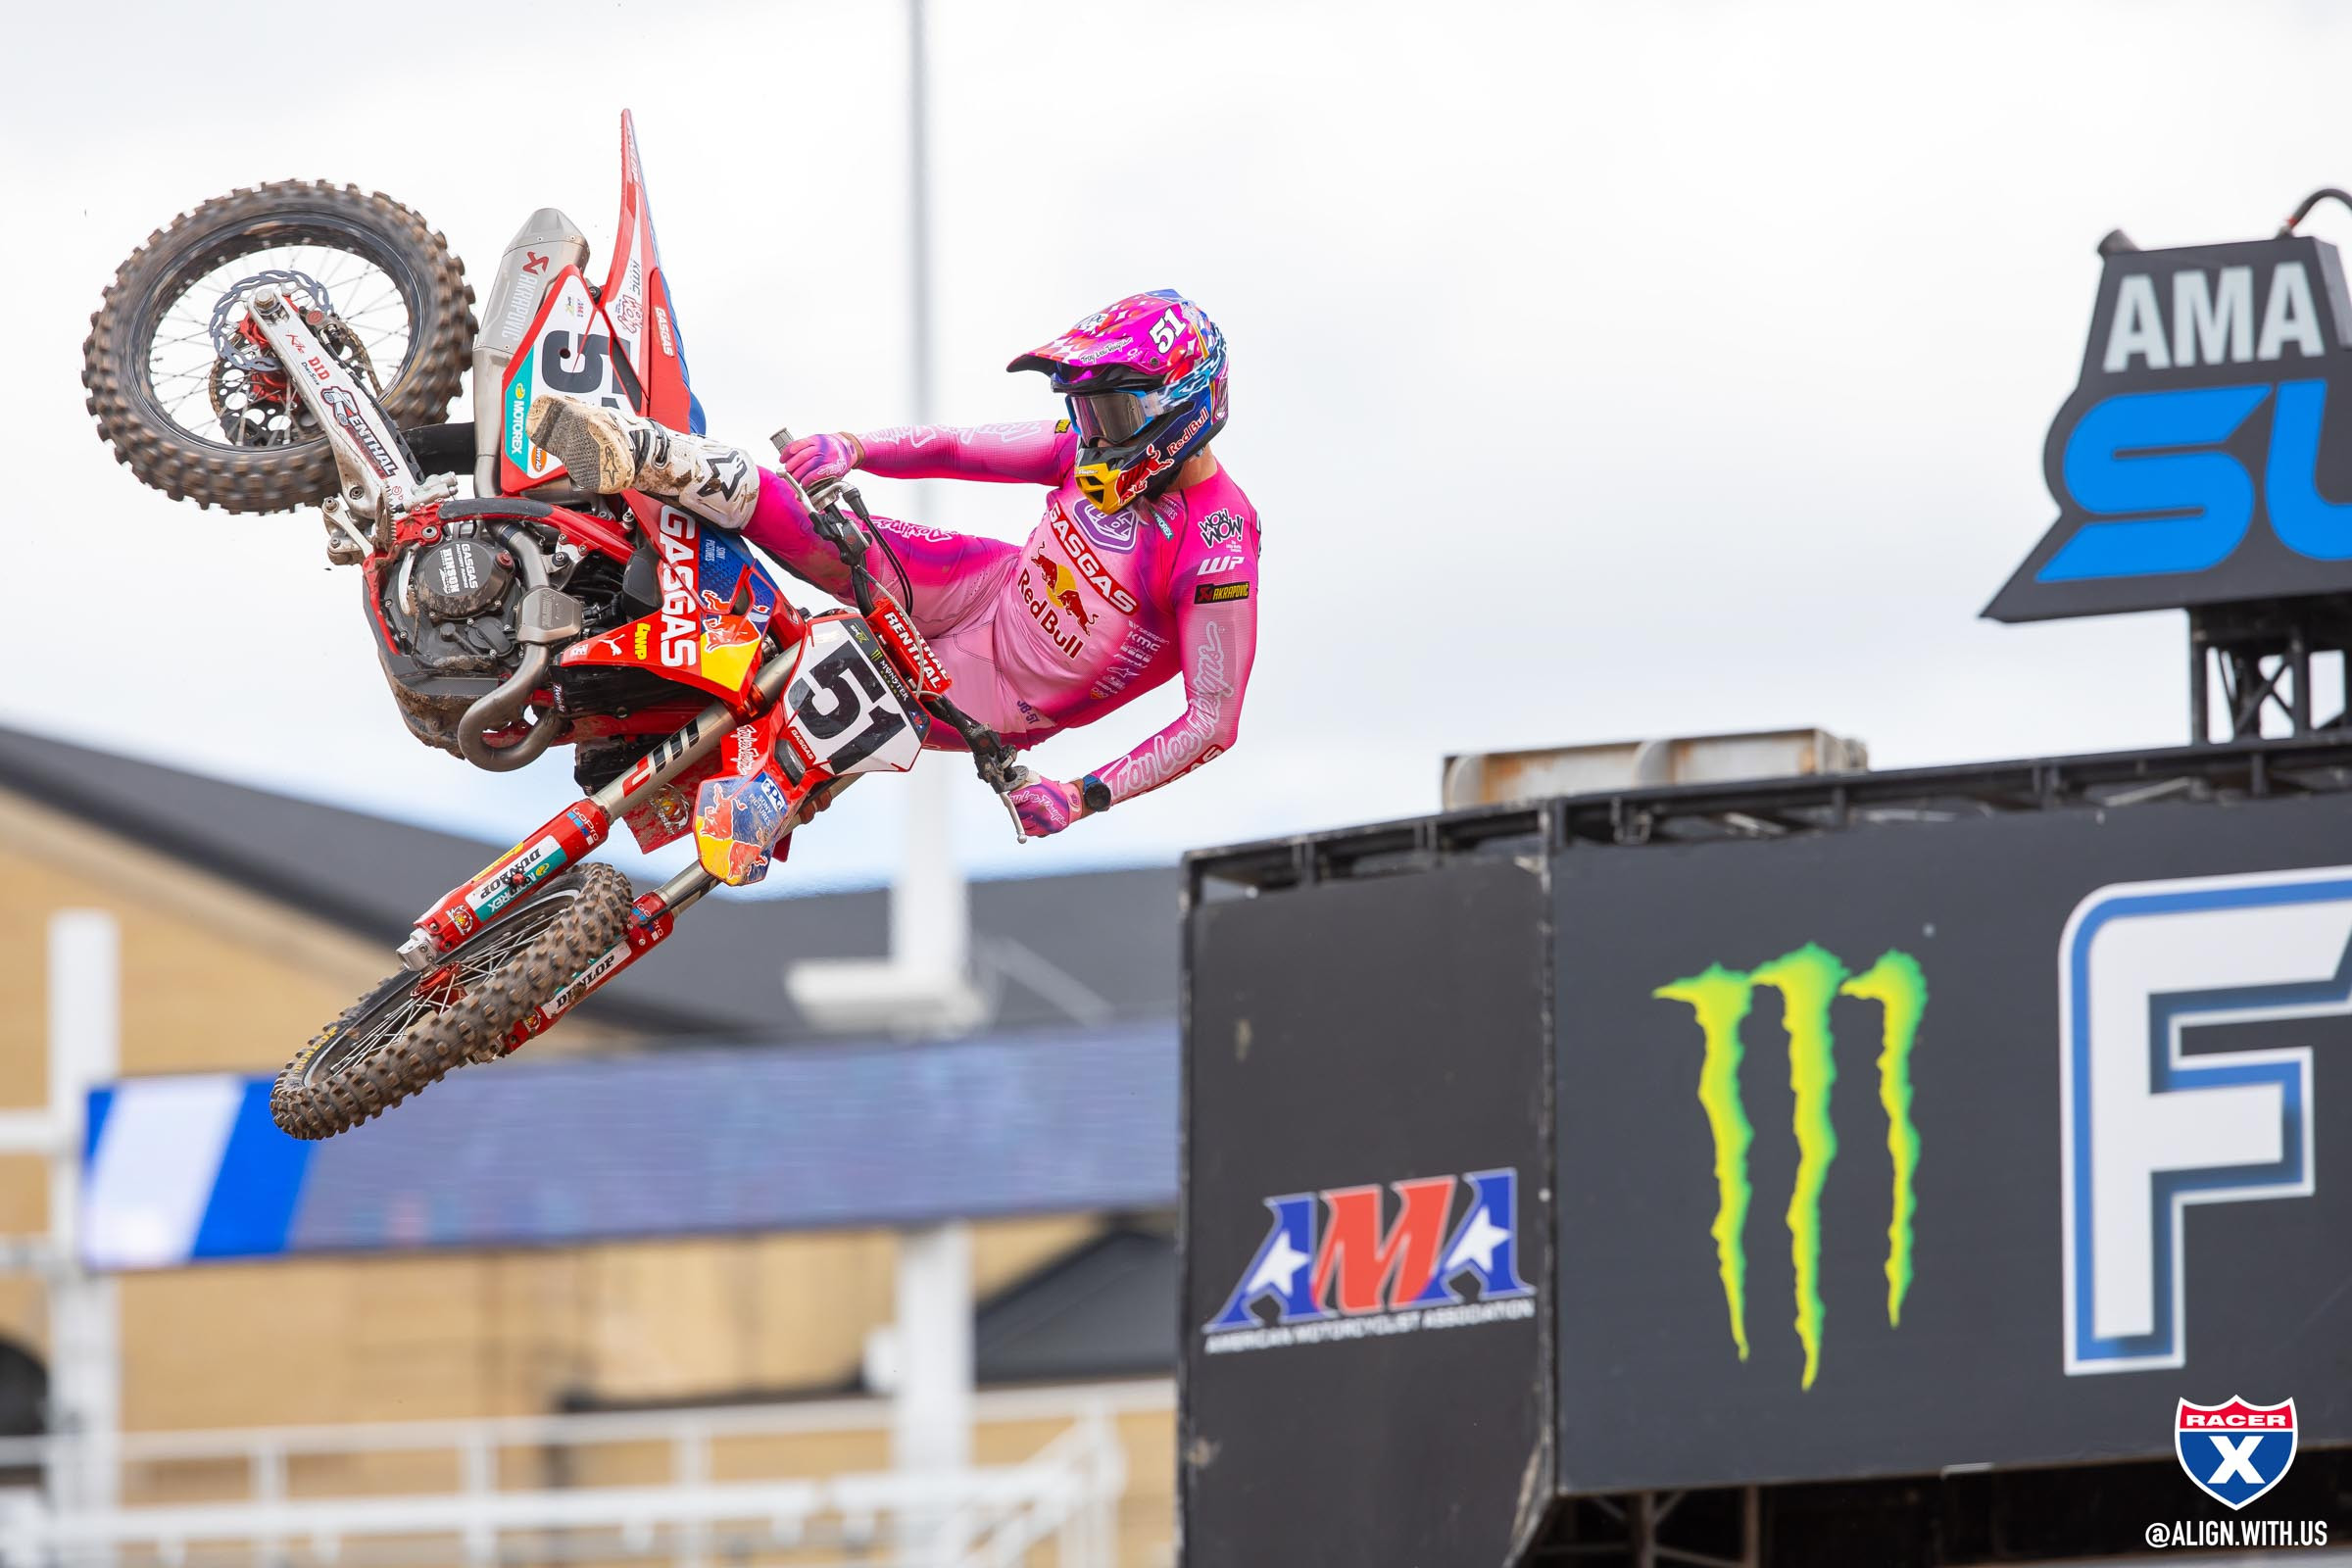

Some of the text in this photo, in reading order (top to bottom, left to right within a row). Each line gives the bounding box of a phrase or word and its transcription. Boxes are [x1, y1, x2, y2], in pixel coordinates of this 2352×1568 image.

[655, 307, 674, 357] GASGAS
[1149, 307, 1187, 355] 51
[2102, 261, 2326, 373] AMA
[542, 330, 631, 410] 5
[512, 400, 525, 455] MOTOREX
[1167, 408, 1210, 457] Red Bull
[1200, 509, 1230, 533] WOW
[442, 548, 461, 593] HINSON
[461, 543, 478, 589] GASGAS
[1050, 504, 1138, 614] GASGAS
[1197, 556, 1245, 576] WP
[659, 504, 697, 667] GASGAS
[1017, 566, 1084, 660] Red Bull
[1126, 630, 1161, 654] KMC
[879, 660, 909, 703] MONSTER
[787, 640, 907, 775] 51
[791, 729, 813, 760] GASGAS
[570, 807, 600, 842] GoPro
[749, 793, 772, 827] PICTURES
[758, 795, 772, 813] SONY
[1201, 1167, 1539, 1334] AMA
